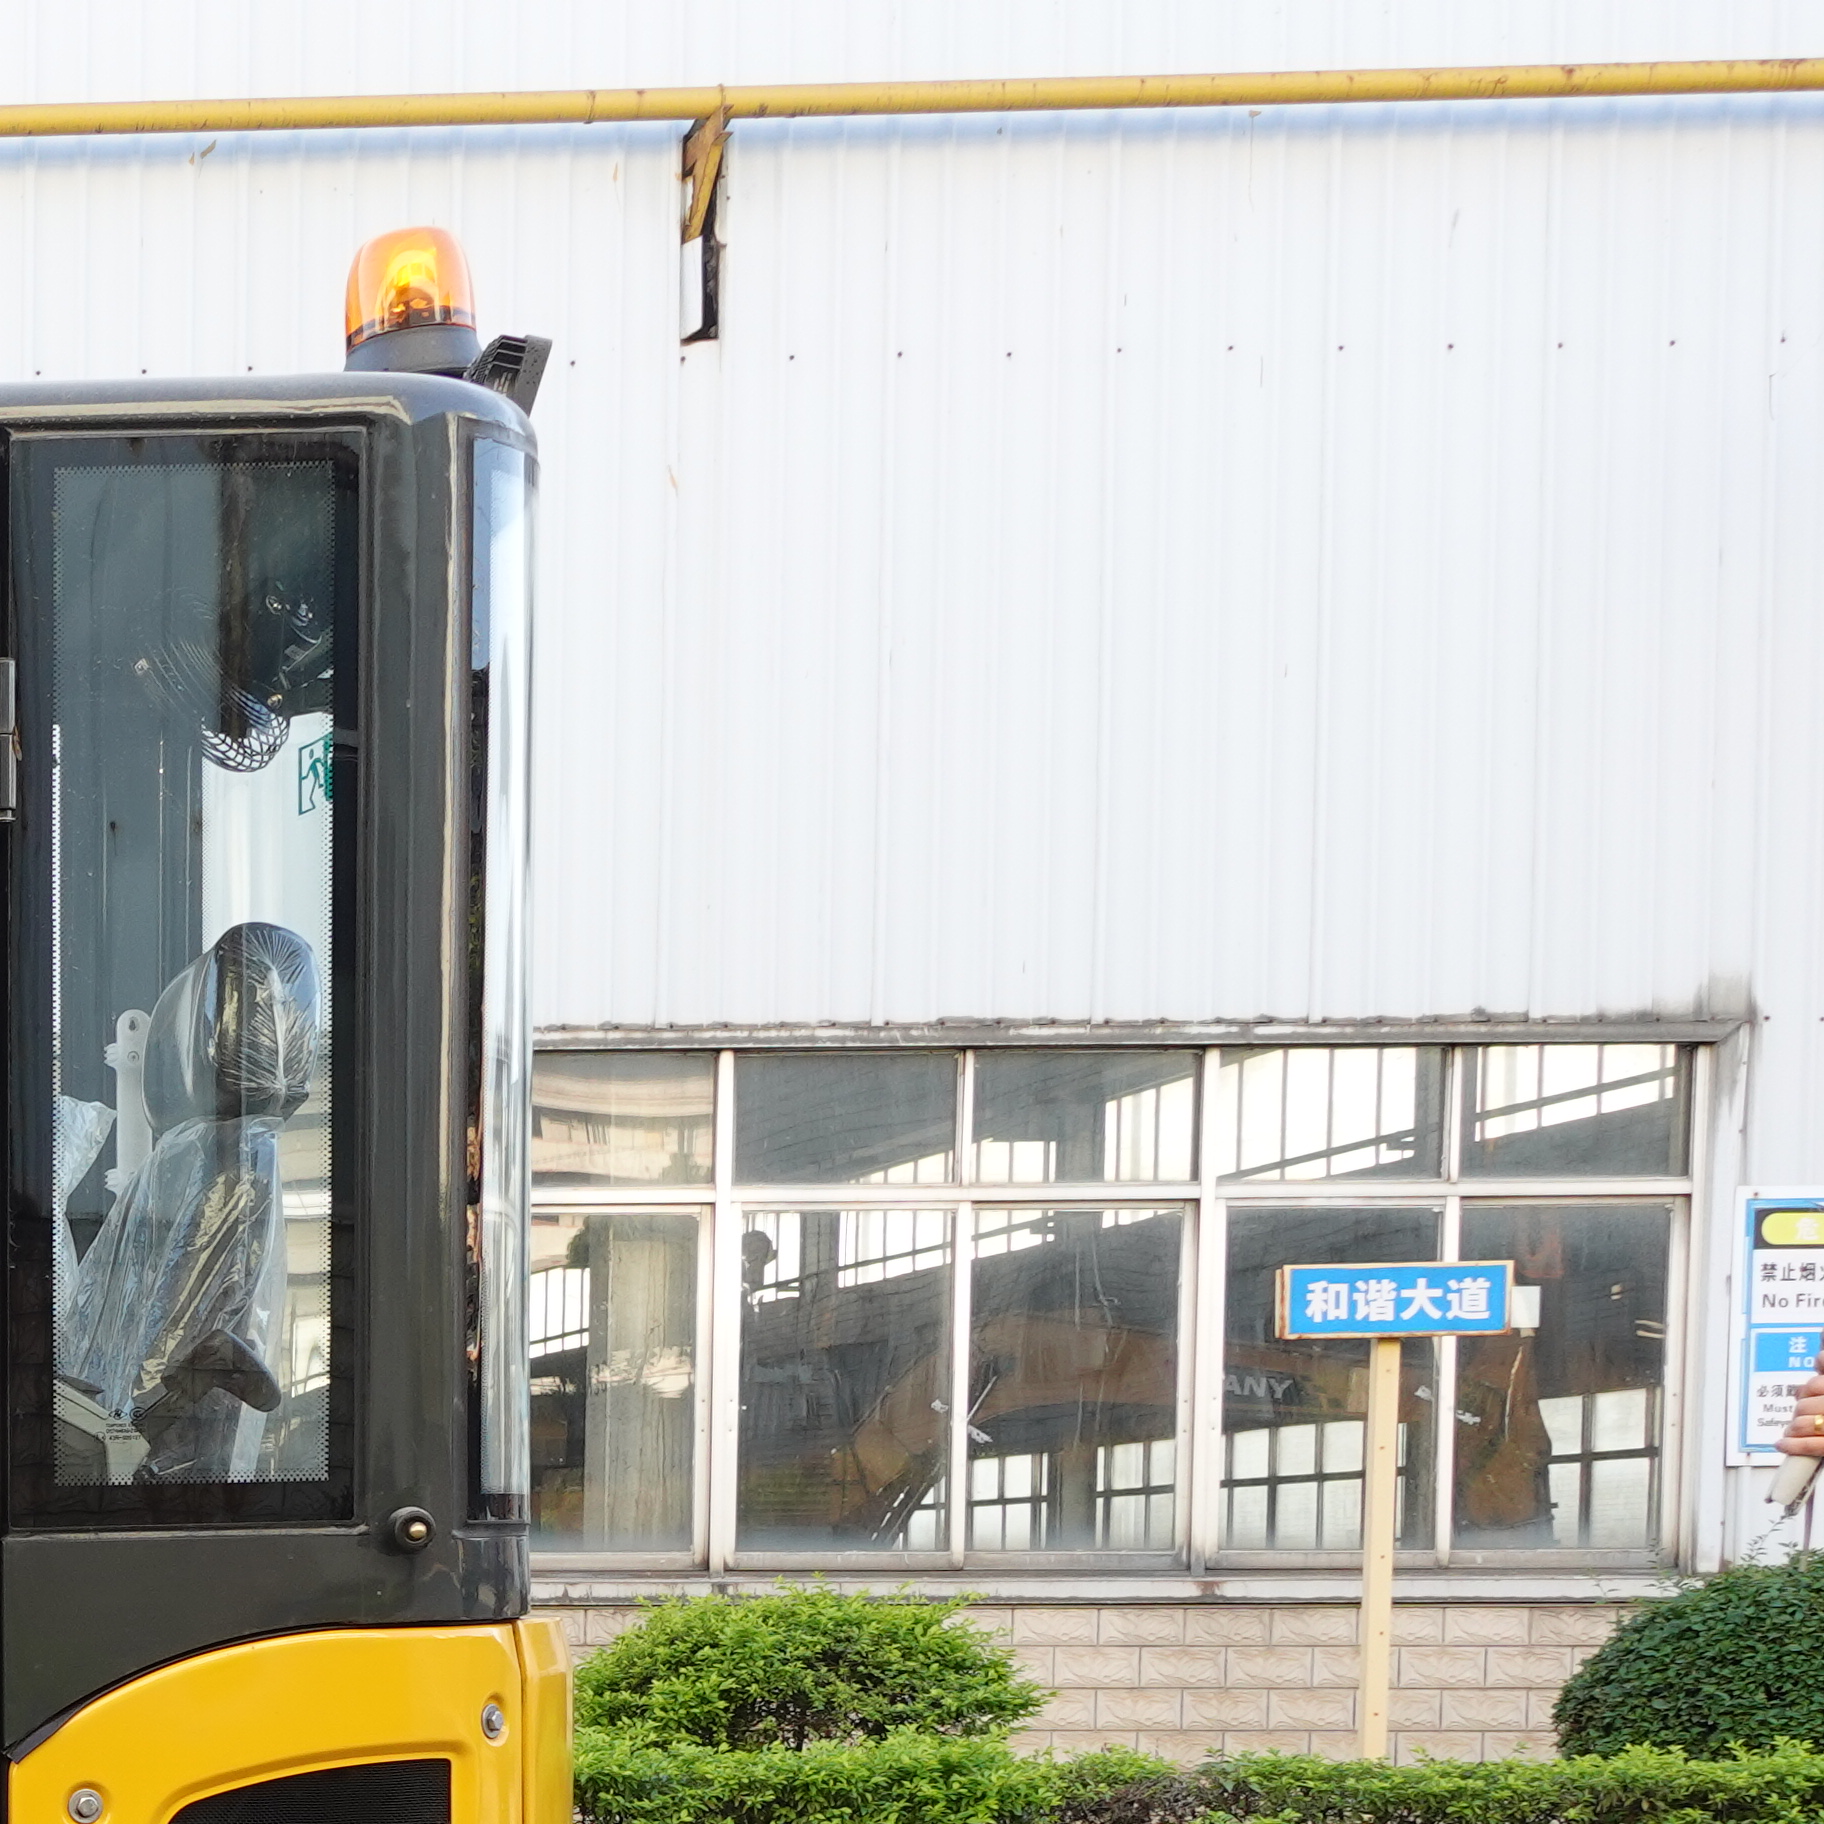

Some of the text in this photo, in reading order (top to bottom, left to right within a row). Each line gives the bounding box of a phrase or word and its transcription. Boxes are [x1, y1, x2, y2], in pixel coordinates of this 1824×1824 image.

[1305, 1276, 1492, 1323] 和谐大道
[1762, 1293, 1789, 1309] No
[1763, 1403, 1794, 1413] Must
